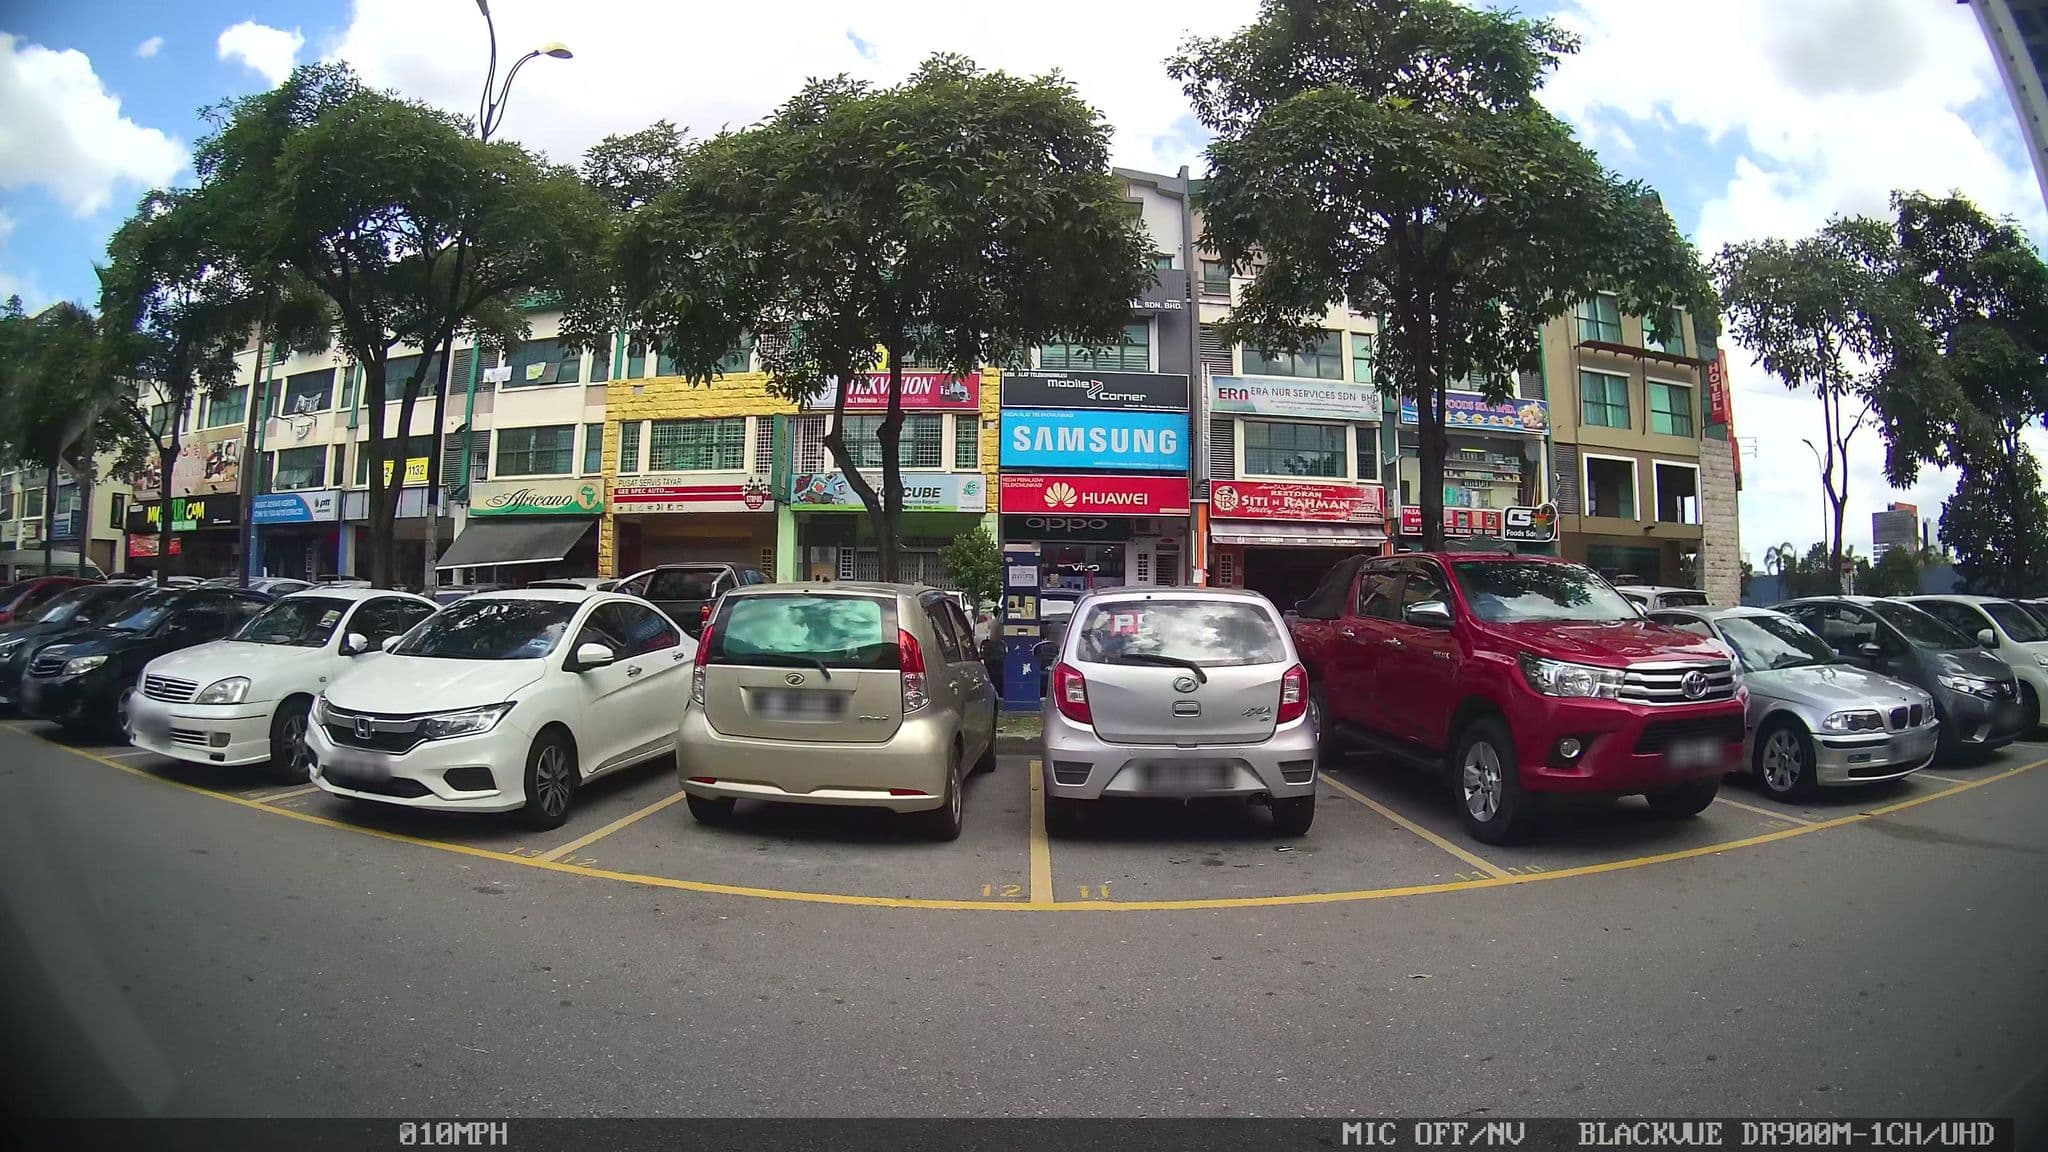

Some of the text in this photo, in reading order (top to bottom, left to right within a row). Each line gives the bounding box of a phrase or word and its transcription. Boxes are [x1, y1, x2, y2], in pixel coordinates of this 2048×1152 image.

[1144, 301, 1163, 309] SDN.
[1164, 302, 1184, 310] BHD.
[1047, 379, 1090, 389] Mobile
[1708, 362, 1722, 411] HOTEL
[1099, 392, 1147, 402] Corner
[1251, 386, 1269, 396] ERA
[1271, 388, 1291, 397] NUR
[1293, 389, 1336, 401] SERVICES
[1337, 392, 1356, 402] SDN
[1013, 425, 1178, 455] SAMSUNG
[408, 464, 425, 476] 1132
[618, 477, 682, 487] PUSAT SERVIS TAYAR
[486, 488, 573, 513] Africano
[1082, 492, 1148, 505] HUAWEI
[1270, 490, 1322, 498] RESTORAN
[1241, 494, 1268, 507] SITI
[1284, 496, 1350, 510] RAHMAN
[1506, 529, 1525, 537] Foods
[1071, 562, 1101, 572] vio
[1115, 614, 1135, 632] P
[981, 884, 1023, 898] 12
[1080, 884, 1111, 899] 11
